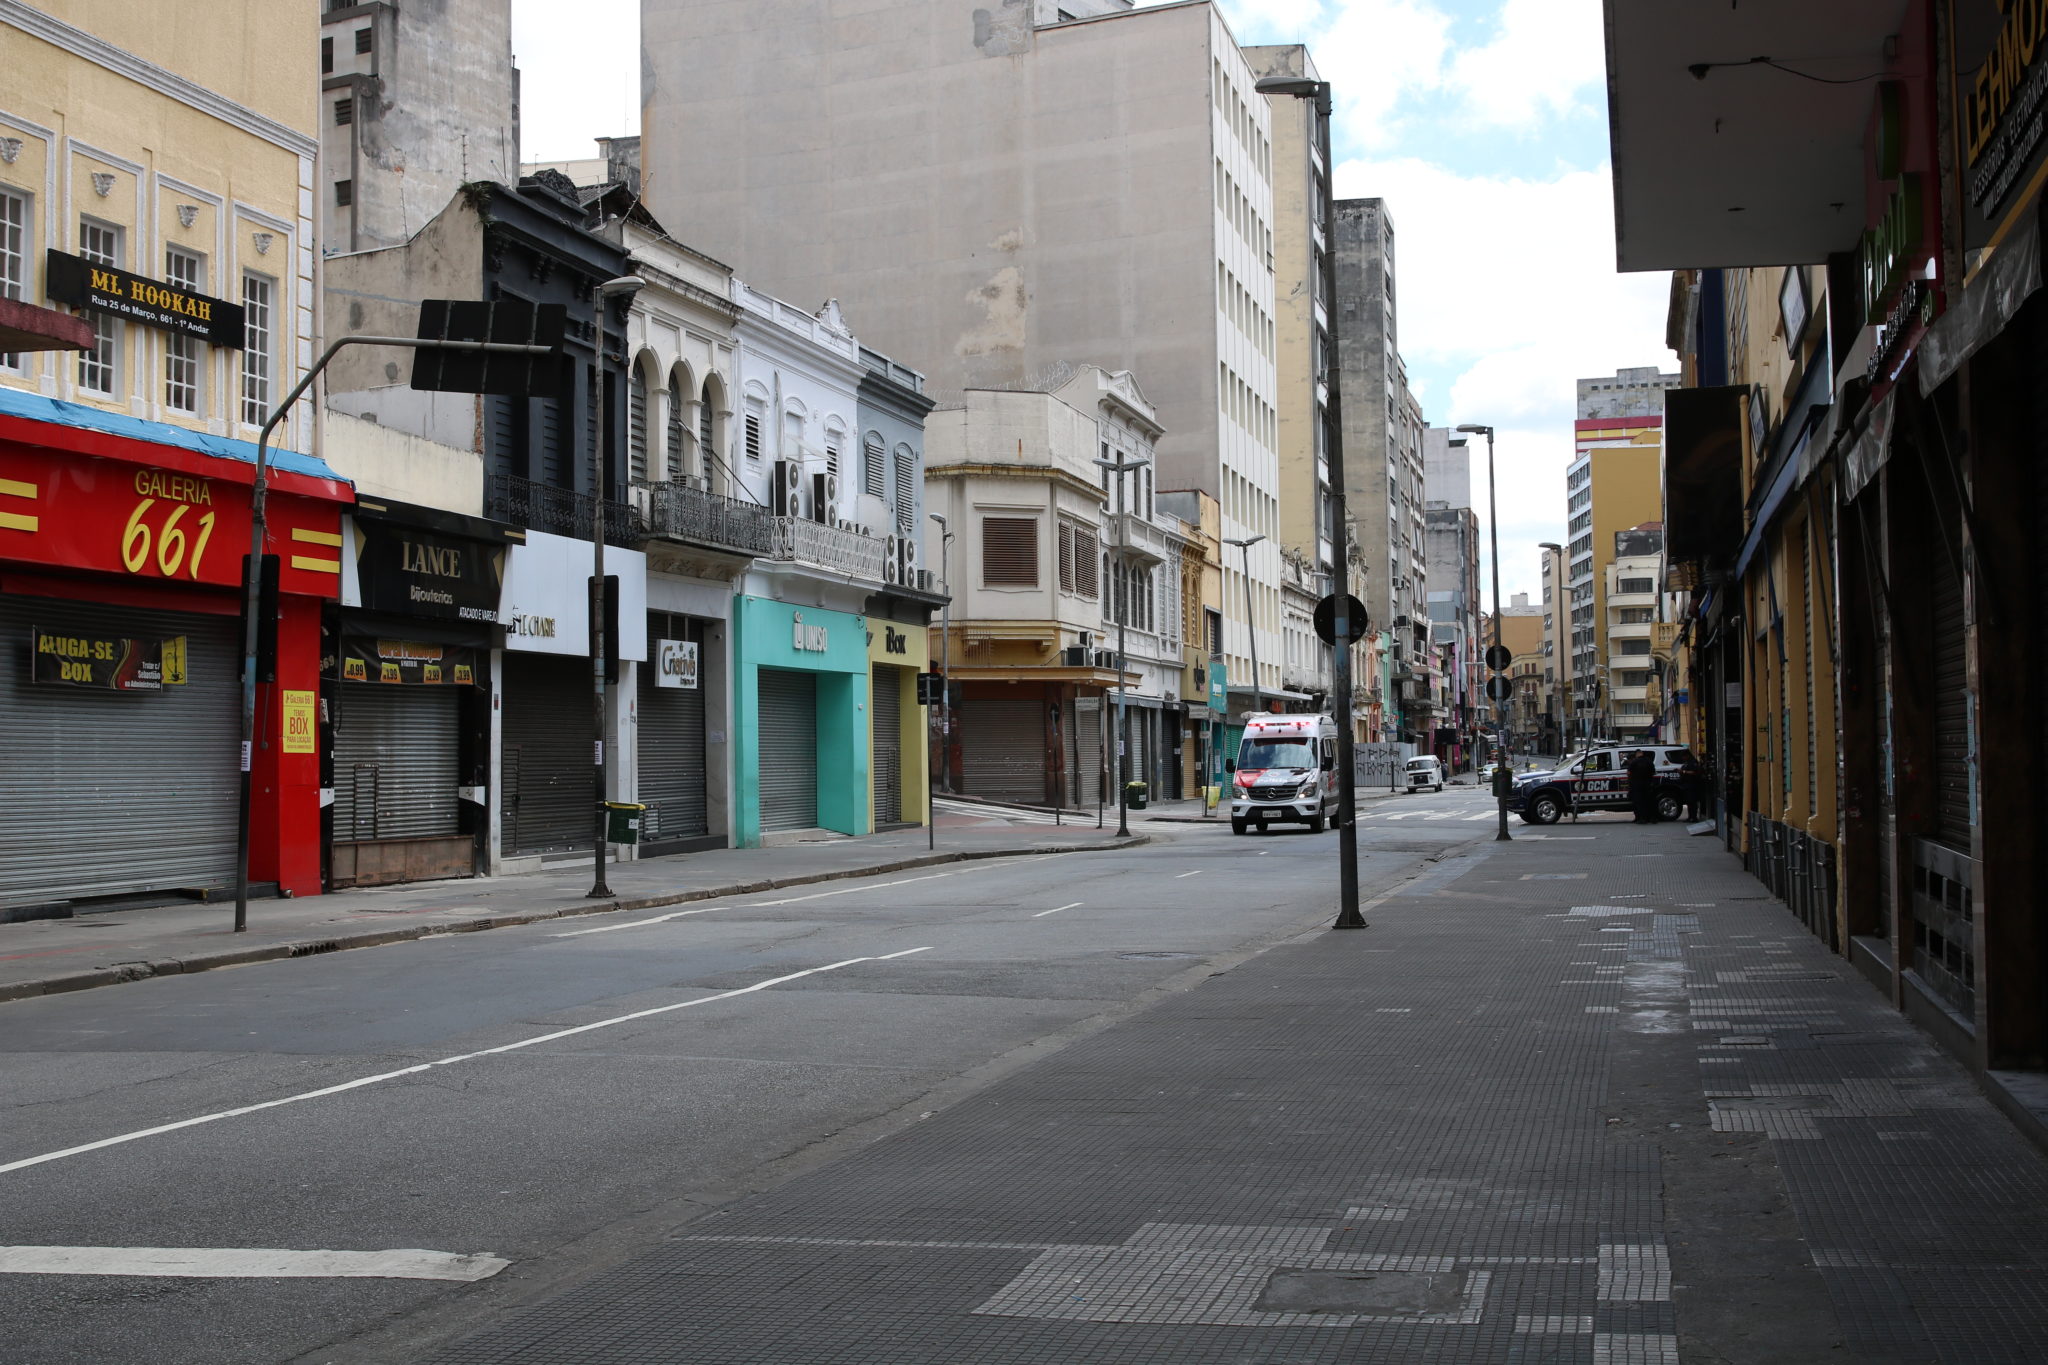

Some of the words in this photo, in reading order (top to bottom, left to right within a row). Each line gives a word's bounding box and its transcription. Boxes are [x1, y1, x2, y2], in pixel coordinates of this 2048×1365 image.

[1964, 0, 2048, 169] LEHMO
[91, 269, 122, 296] ML
[131, 280, 211, 321] HOOKAH
[91, 295, 107, 307] Rua
[109, 300, 119, 310] 25
[121, 303, 130, 313] de
[160, 313, 173, 324] 661
[188, 321, 210, 334] Andar
[135, 470, 211, 506] GALERIA
[122, 498, 215, 580] 661
[402, 541, 461, 578] LANCE
[410, 584, 453, 605] Bijouterias
[459, 607, 478, 619] ATACADO
[482, 610, 498, 622] VAREJO
[38, 634, 113, 660] ALUGA-SE
[805, 624, 828, 651] UNISO
[61, 661, 93, 682] BOX
[662, 645, 696, 676] Criativa
[290, 717, 308, 734] BOX
[1587, 780, 1610, 791] GCM
